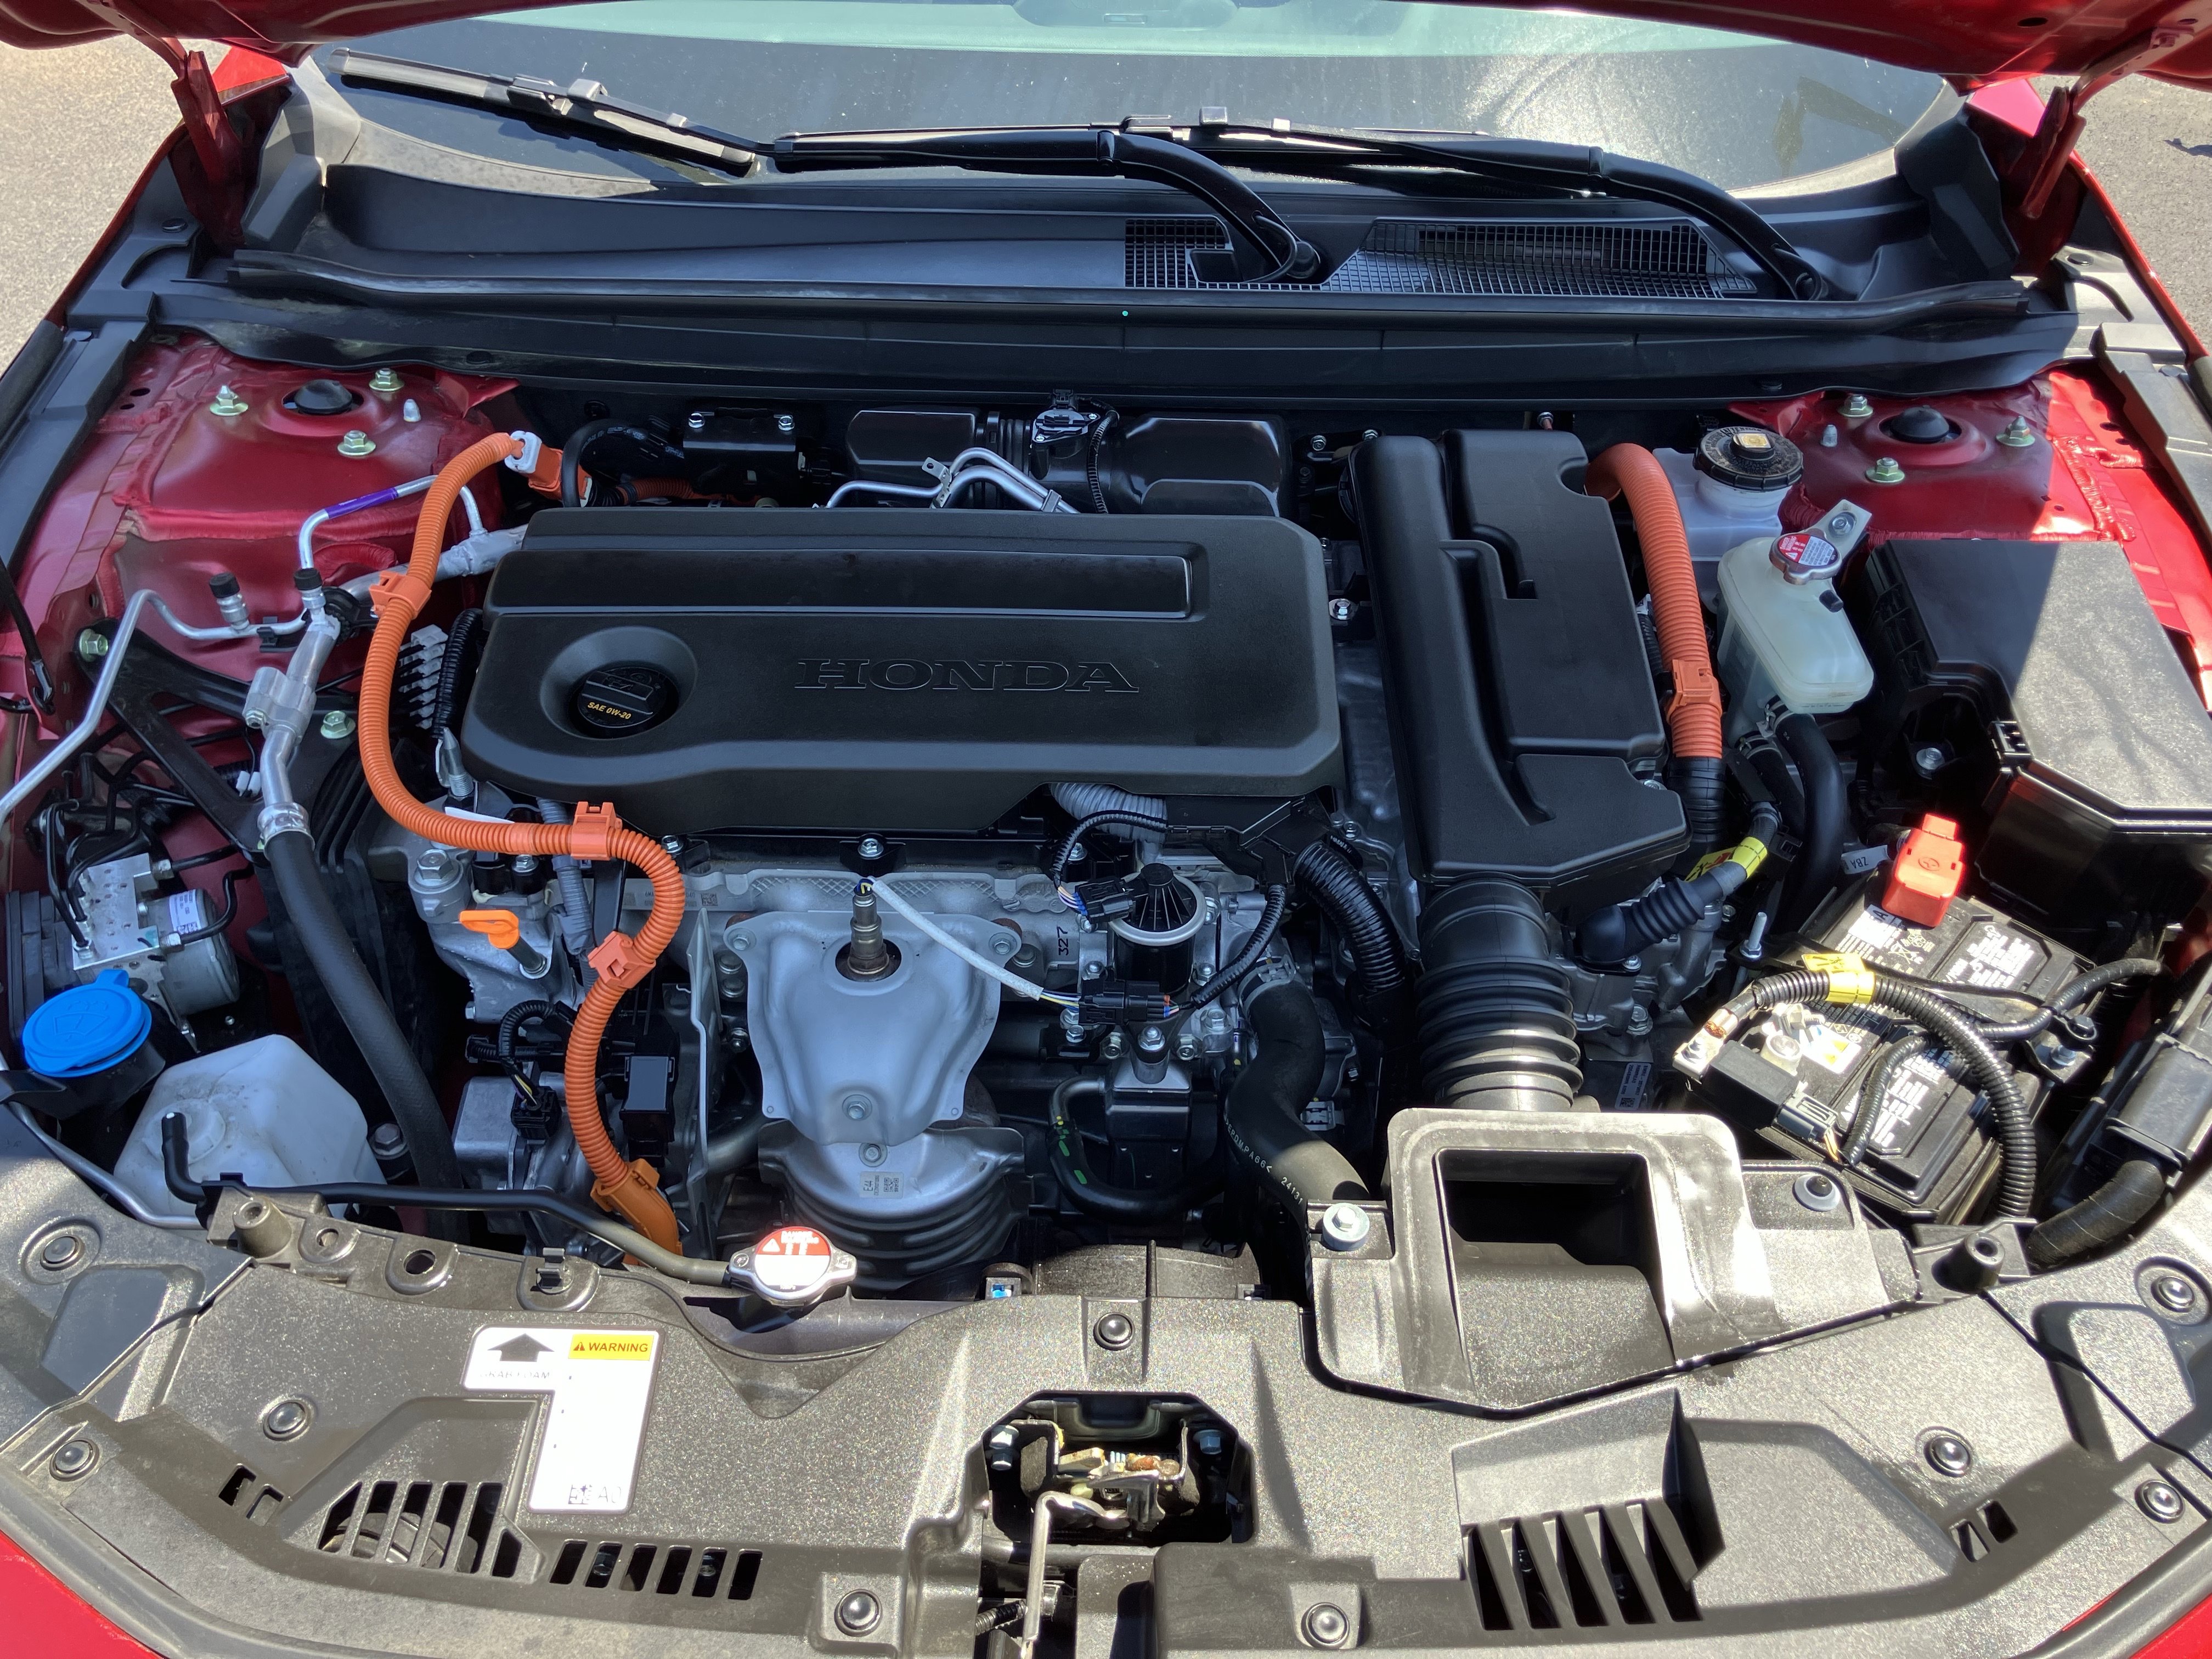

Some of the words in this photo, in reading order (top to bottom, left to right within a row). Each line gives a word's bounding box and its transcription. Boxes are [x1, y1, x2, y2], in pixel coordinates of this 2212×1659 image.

[794, 658, 1139, 693] HONDA
[587, 702, 607, 712] SAE
[606, 707, 631, 720] 0W-20
[1850, 856, 1869, 868] ZBA
[1056, 926, 1069, 956] 327
[863, 1180, 873, 1191] E44
[1281, 1176, 1303, 1205] 24131
[589, 1342, 648, 1352] WARNING
